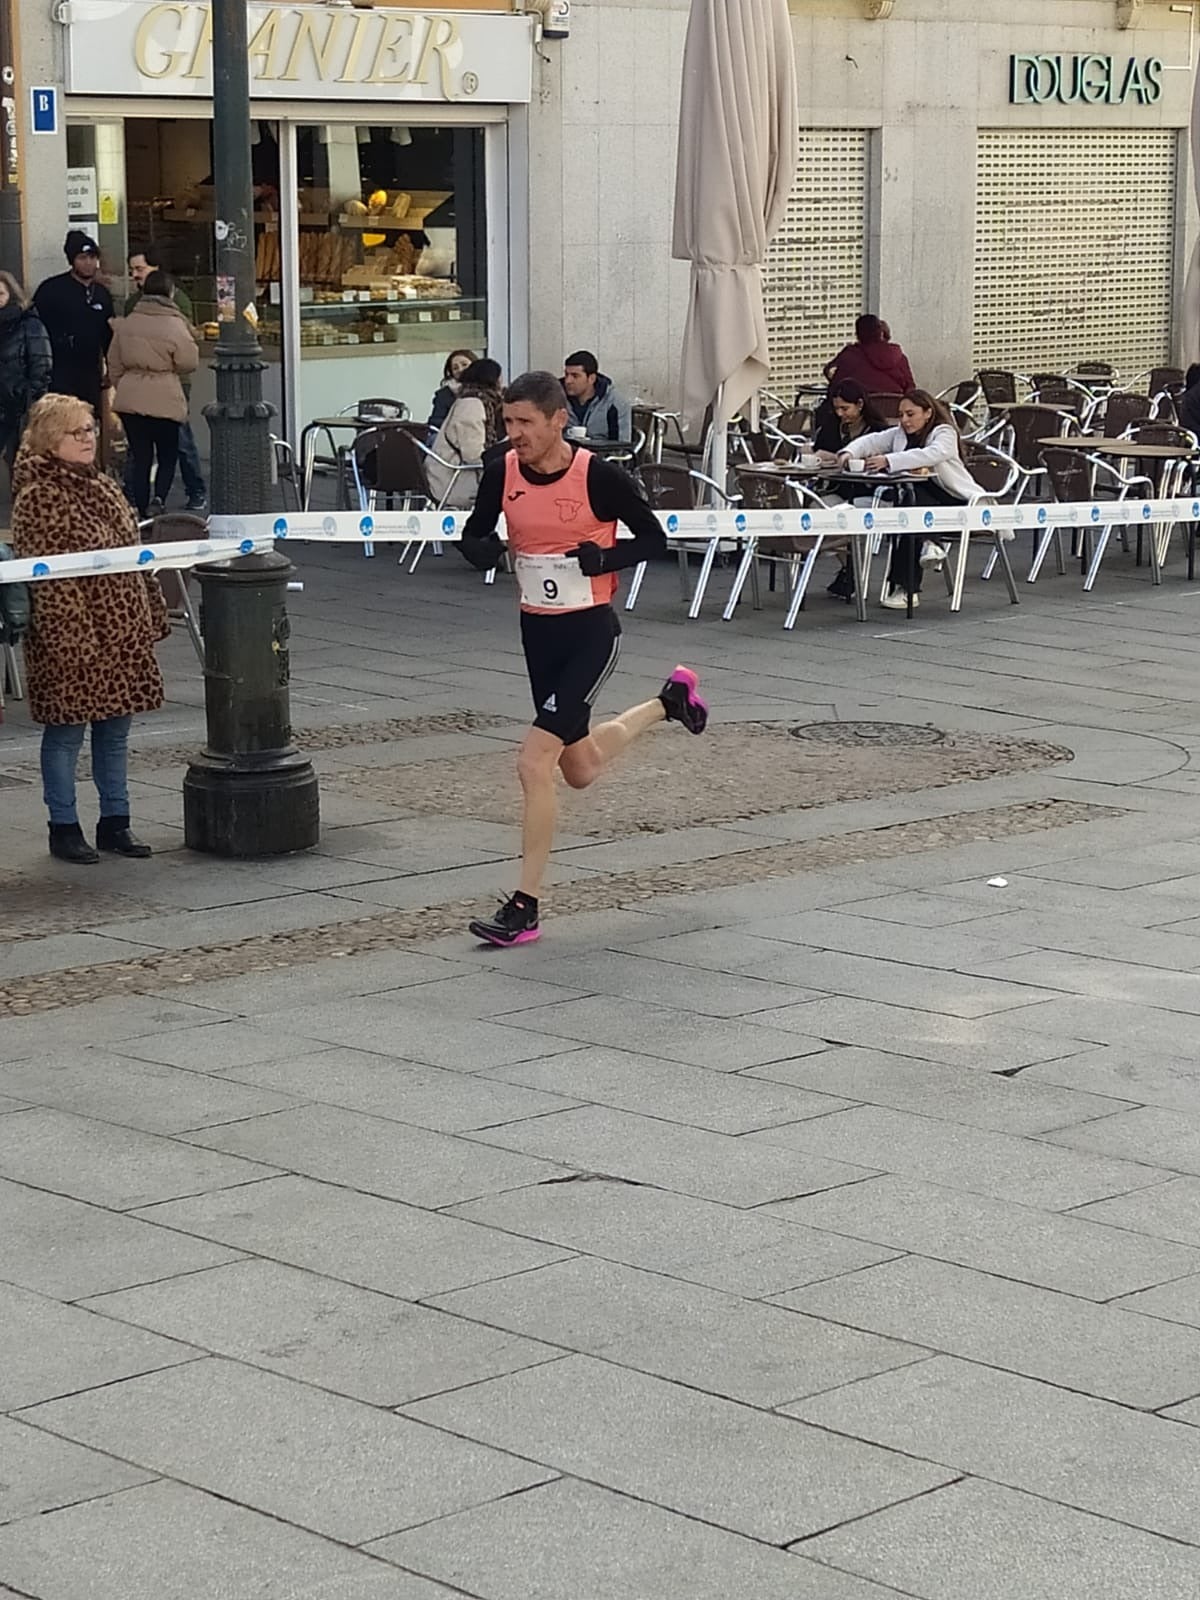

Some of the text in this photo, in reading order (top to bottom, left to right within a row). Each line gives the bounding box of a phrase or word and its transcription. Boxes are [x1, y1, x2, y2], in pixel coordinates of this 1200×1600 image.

[1009, 53, 1163, 105] DOUGLAS
[39, 94, 49, 111] B
[543, 579, 558, 600] 9
